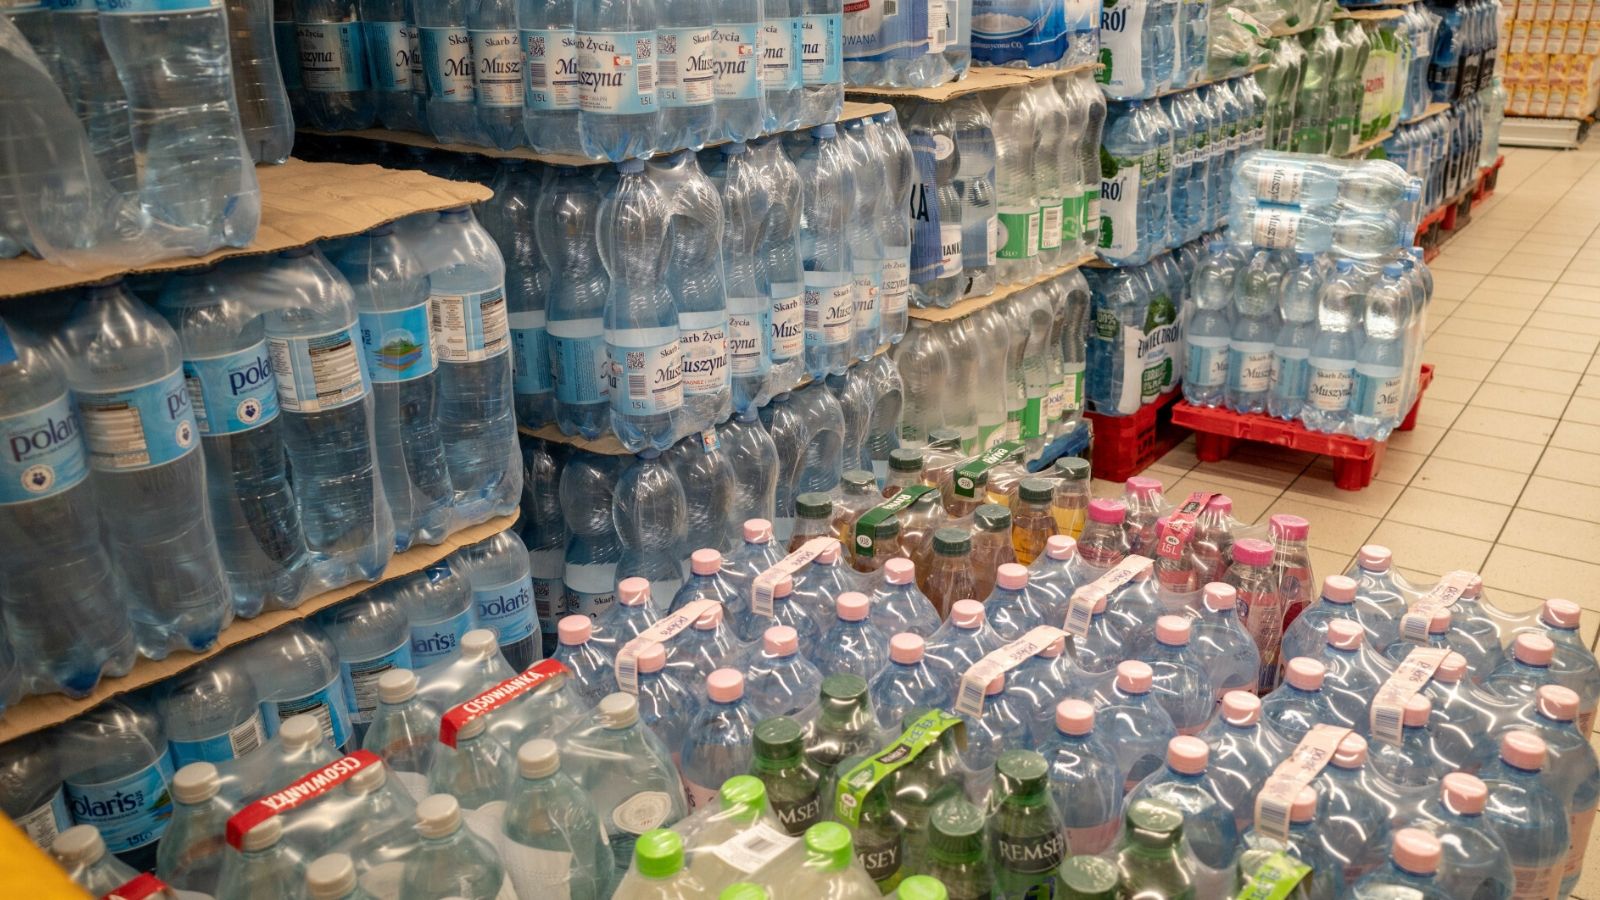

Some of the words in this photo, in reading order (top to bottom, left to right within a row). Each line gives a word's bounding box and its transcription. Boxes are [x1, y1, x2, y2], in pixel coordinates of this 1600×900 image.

[484, 36, 511, 47] Skarb
[712, 28, 740, 43] Życia
[773, 299, 798, 313] Skarb
[463, 671, 545, 715] CISOWIANKA
[261, 756, 361, 811] CISOWIANKA
